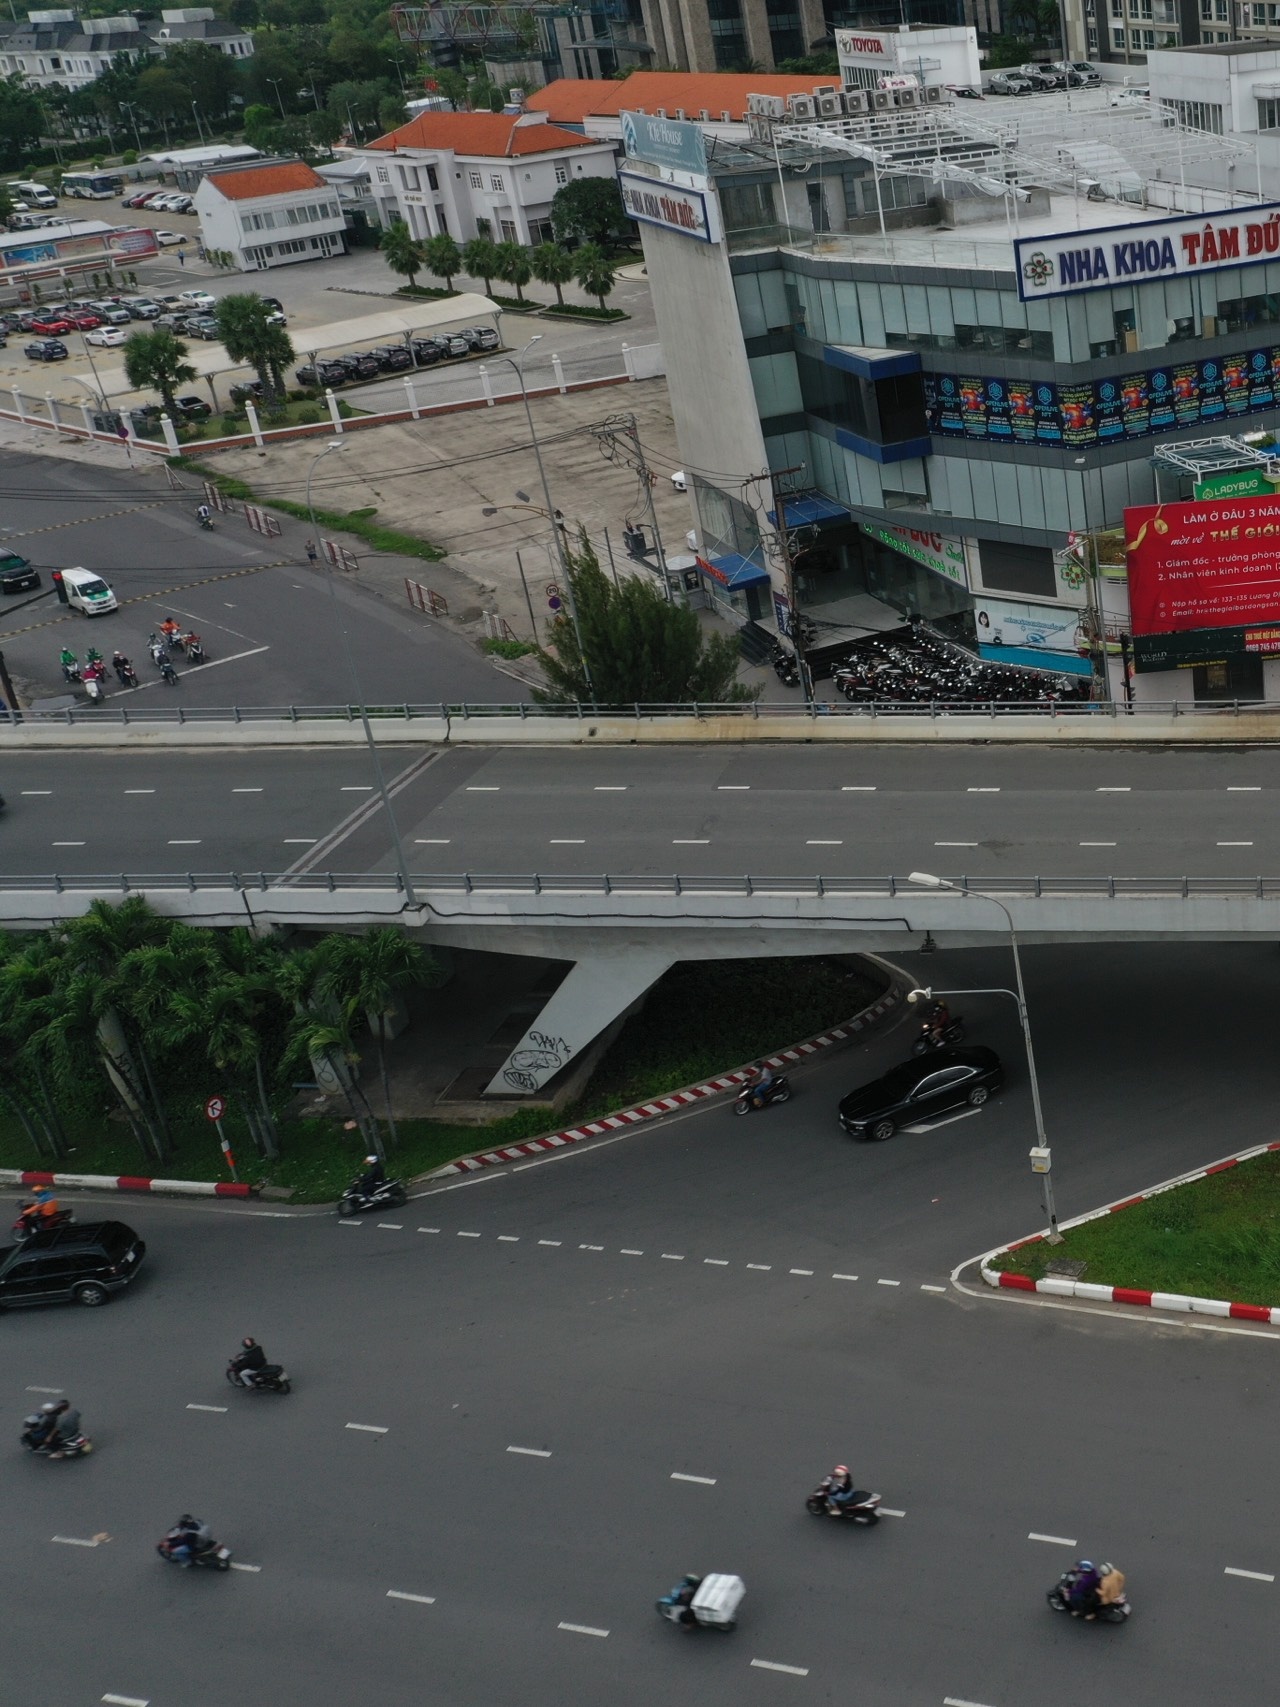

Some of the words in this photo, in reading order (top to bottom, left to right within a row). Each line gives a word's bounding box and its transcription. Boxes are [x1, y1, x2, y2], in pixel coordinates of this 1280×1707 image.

[851, 37, 883, 53] TOYOTA
[1057, 246, 1108, 286] NHA
[1113, 236, 1176, 277] KHOA
[1182, 223, 1240, 266] TÂM
[1248, 370, 1272, 379] OPENLIVE
[1200, 380, 1222, 389] OPENLIVE
[1148, 390, 1173, 400] OPENLIVE
[986, 400, 1009, 408] OPENLIVE
[1034, 404, 1058, 413] OPENLIVE
[1096, 400, 1121, 410] OPENLIVE
[1215, 479, 1258, 495] LADYBUG
[1183, 514, 1207, 524] LÀM
[1210, 510, 1218, 522] Ở
[1222, 508, 1245, 520] ĐÂU
[1249, 508, 1256, 518] 3
[1210, 525, 1240, 542] THẾ
[1244, 522, 1280, 538] GIỚI
[1166, 560, 1190, 568] Giám
[1192, 557, 1210, 566] đốc
[1218, 553, 1249, 563] trưởng
[1252, 550, 1280, 562] phòng
[1168, 570, 1194, 580] Nhân
[1196, 568, 1216, 577] viên
[1220, 566, 1240, 575] kinh
[1242, 564, 1272, 573] doanh
[1172, 600, 1186, 608] Nộp
[1222, 594, 1248, 603] 133-135
